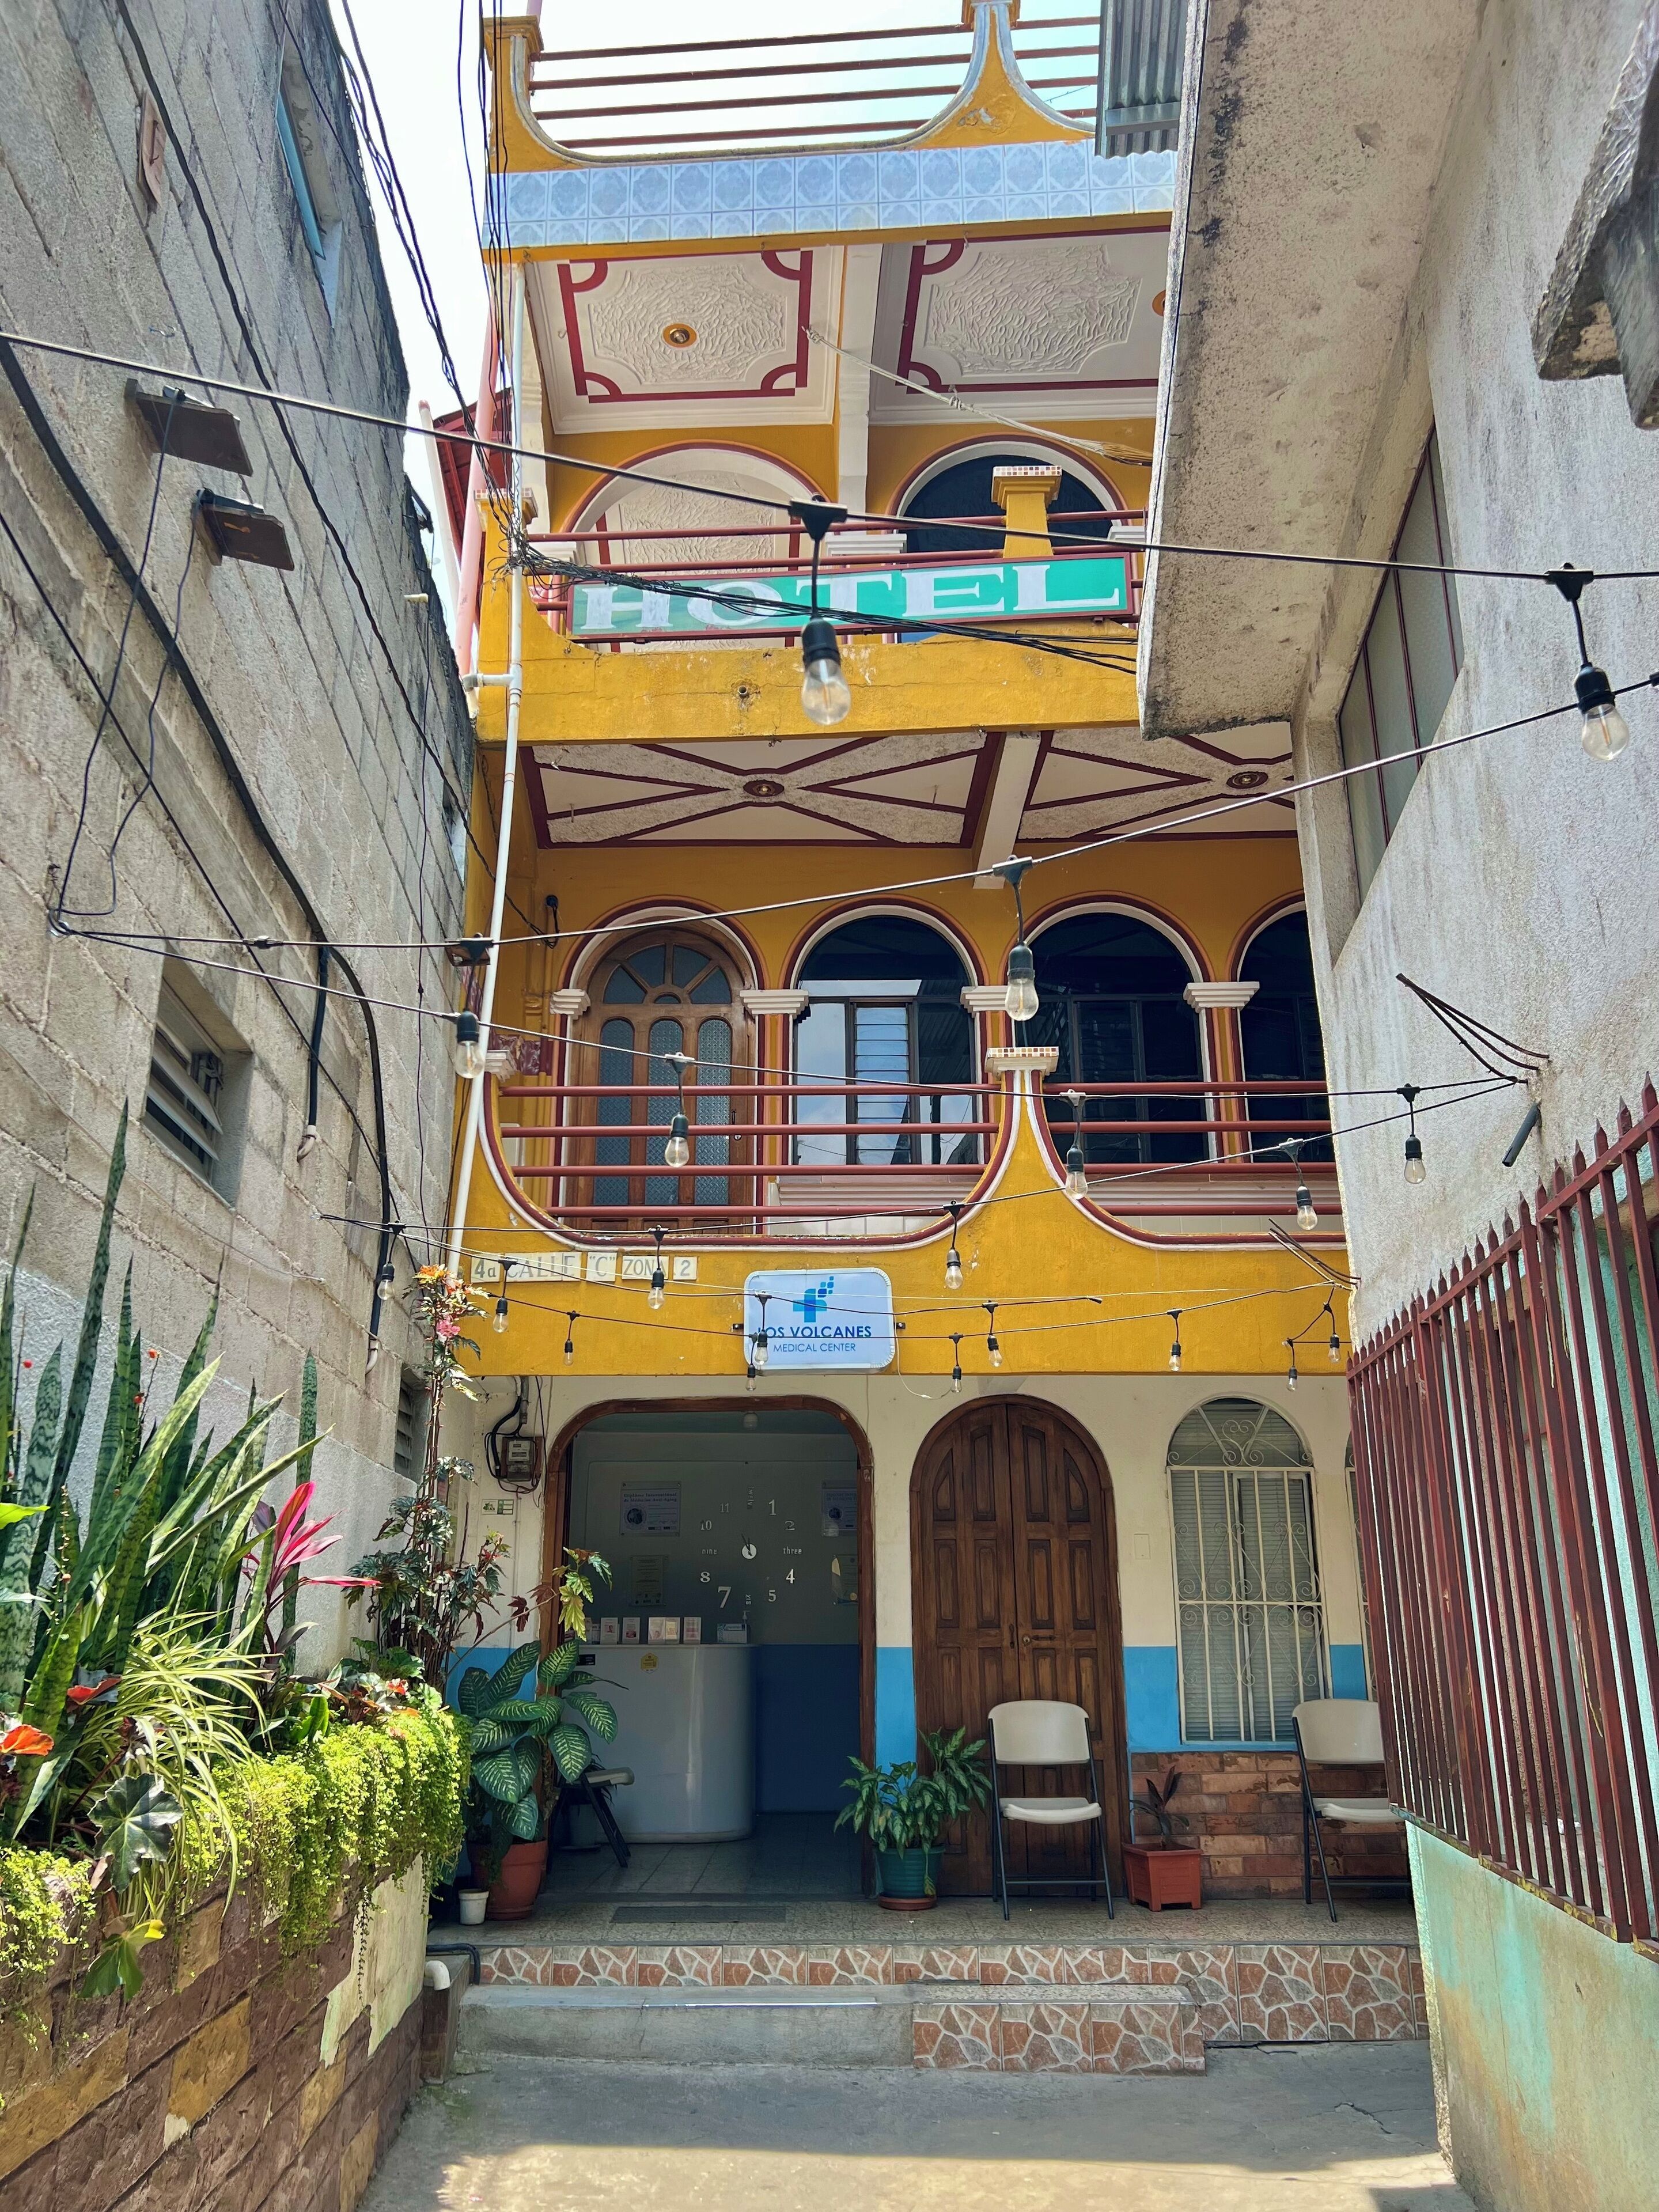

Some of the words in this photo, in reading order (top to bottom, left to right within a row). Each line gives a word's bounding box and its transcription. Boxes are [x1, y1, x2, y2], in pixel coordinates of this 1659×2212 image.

[580, 563, 1120, 630] HOTEL
[680, 1259, 691, 1277] 2
[790, 1325, 872, 1338] VOLCANES
[773, 1343, 817, 1353] MEDICAL
[820, 1343, 856, 1352] CENTER
[720, 1502, 730, 1513] 11
[768, 1499, 777, 1516] 1
[700, 1520, 712, 1531] 10
[785, 1520, 796, 1531] 2
[783, 1546, 802, 1555] three
[700, 1571, 710, 1583] 8
[786, 1569, 796, 1584] 4
[718, 1586, 732, 1608] 7
[768, 1589, 777, 1603] 5
